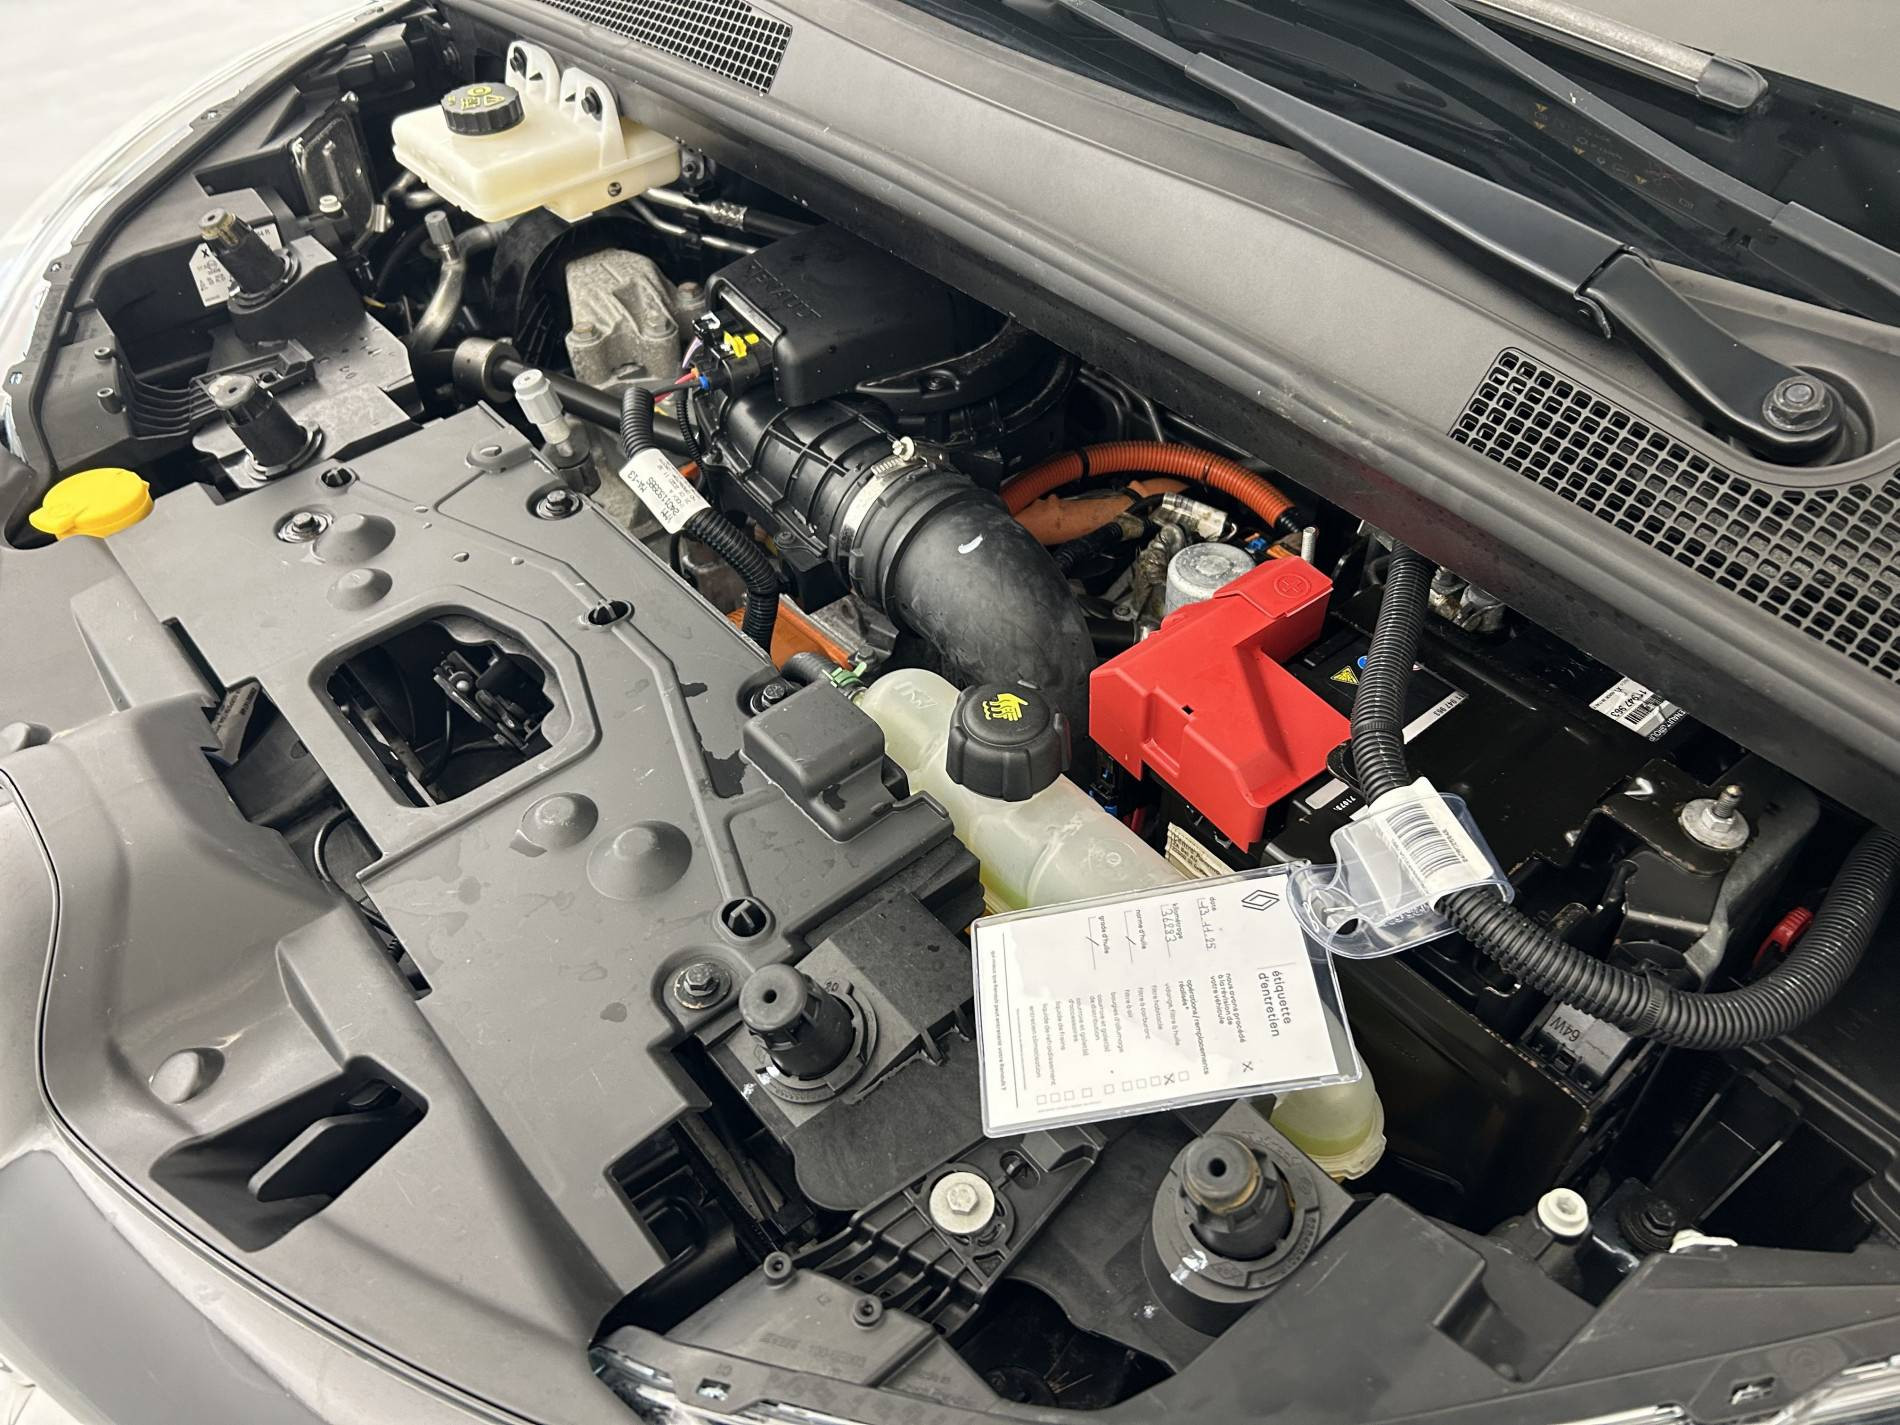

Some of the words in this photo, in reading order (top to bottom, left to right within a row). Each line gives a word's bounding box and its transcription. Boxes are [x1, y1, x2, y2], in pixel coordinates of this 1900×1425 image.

[1625, 694, 1639, 707] 947
[1610, 705, 1626, 717] 963
[1208, 896, 1218, 911] date
[1097, 915, 1107, 933] grade
[1135, 909, 1143, 928] norme
[1170, 902, 1185, 939] kilométrage
[1101, 933, 1110, 954] d'huile
[1138, 929, 1148, 949] d'huile
[1209, 975, 1218, 994] votre
[1224, 972, 1234, 989] nous
[1150, 984, 1158, 999] filtre
[1228, 990, 1239, 1011] avons
[1269, 969, 1295, 1024] étiquette
[1213, 994, 1226, 1024] véhicule
[1220, 987, 1232, 1015] révision
[1226, 1015, 1234, 1025] de
[1257, 971, 1283, 1037] d'entretien
[1140, 1006, 1151, 1040] carburant
[1152, 999, 1164, 1030] habitacle
[1168, 1009, 1177, 1024] filtre
[1232, 1012, 1246, 1043] procédé
[1550, 1016, 1580, 1042] 64W
[1172, 1030, 1181, 1046] huile
